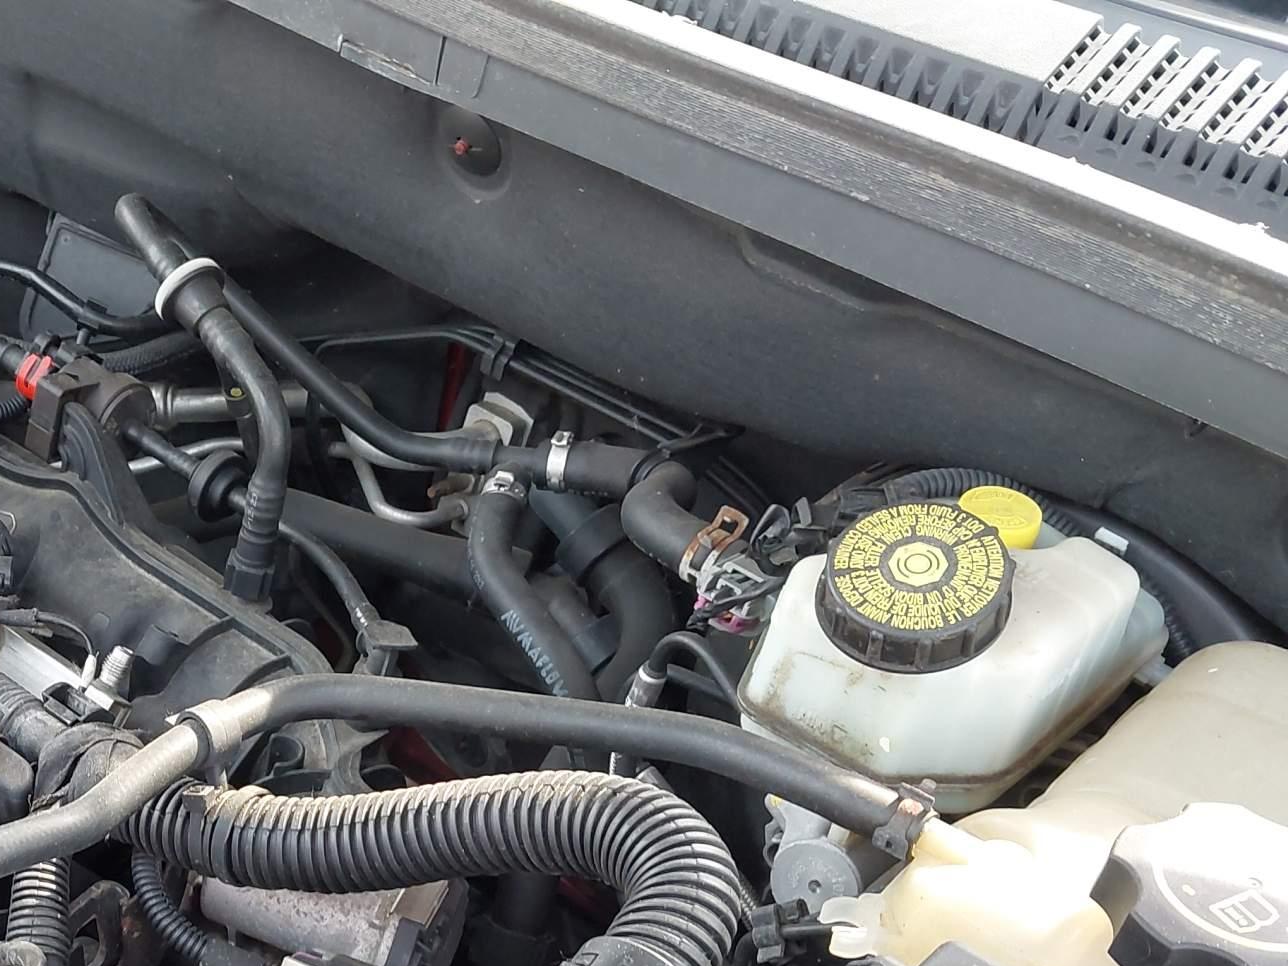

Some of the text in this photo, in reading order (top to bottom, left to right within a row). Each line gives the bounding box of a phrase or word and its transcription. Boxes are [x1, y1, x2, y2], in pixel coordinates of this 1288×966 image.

[834, 504, 985, 569] DOT 3 FLUID FROM A SEALED CONTAINER
[849, 514, 974, 569] CAP BEFORE REMOVING USE ONLY
[863, 525, 960, 566] WARNING CLEAN FILLER
[978, 535, 1004, 578] ATTENTION
[851, 575, 873, 593] DOT
[954, 584, 979, 602] QUE
[861, 588, 893, 611] FREIN
[889, 588, 923, 605] BIDON
[941, 595, 963, 611] DU
[957, 578, 1001, 617] NETTOYER
[855, 601, 891, 624] AVANT
[888, 601, 907, 615] DE
[905, 601, 947, 616] LIQUIDE
[944, 610, 962, 624] LE
[887, 613, 945, 629] BOUCHON
